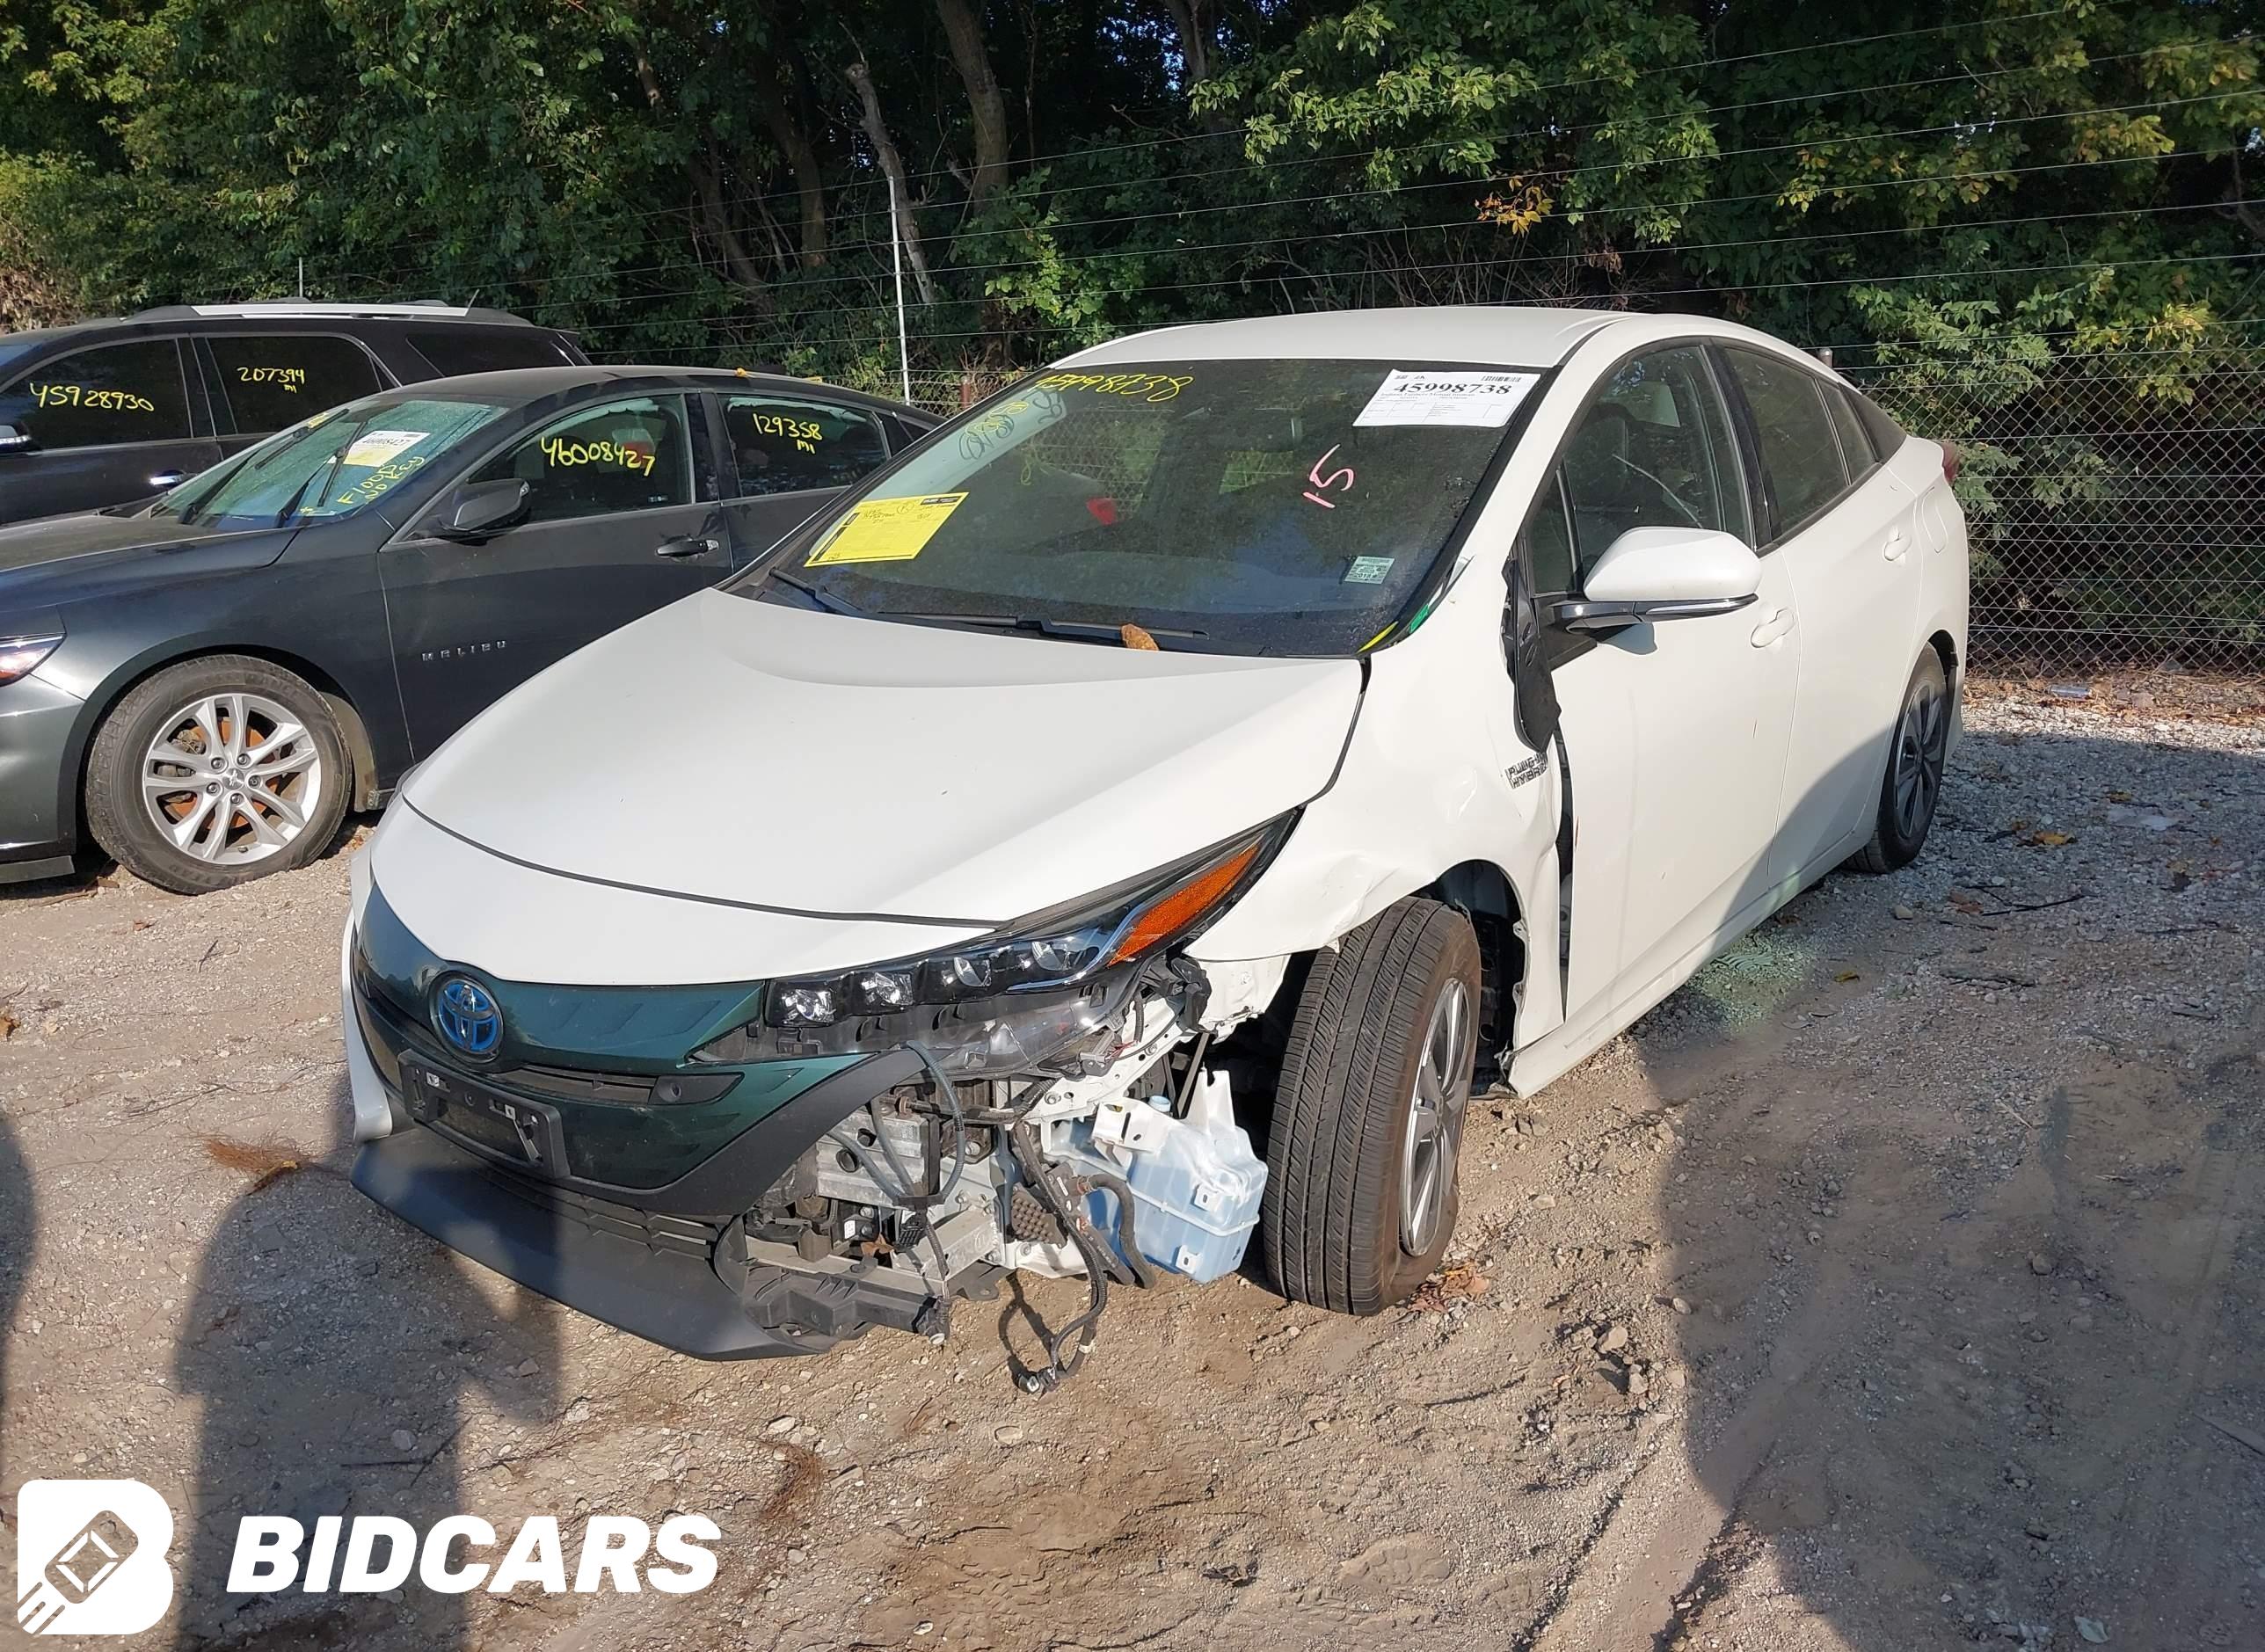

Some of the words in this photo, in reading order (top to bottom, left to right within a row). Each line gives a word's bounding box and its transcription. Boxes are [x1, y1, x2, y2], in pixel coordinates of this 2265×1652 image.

[237, 367, 305, 384] 207394
[30, 382, 155, 411] 45928930
[1393, 382, 1512, 395] 45998738
[753, 413, 823, 440] 129358
[541, 436, 656, 477] 46008427
[422, 640, 507, 662] MALIBU
